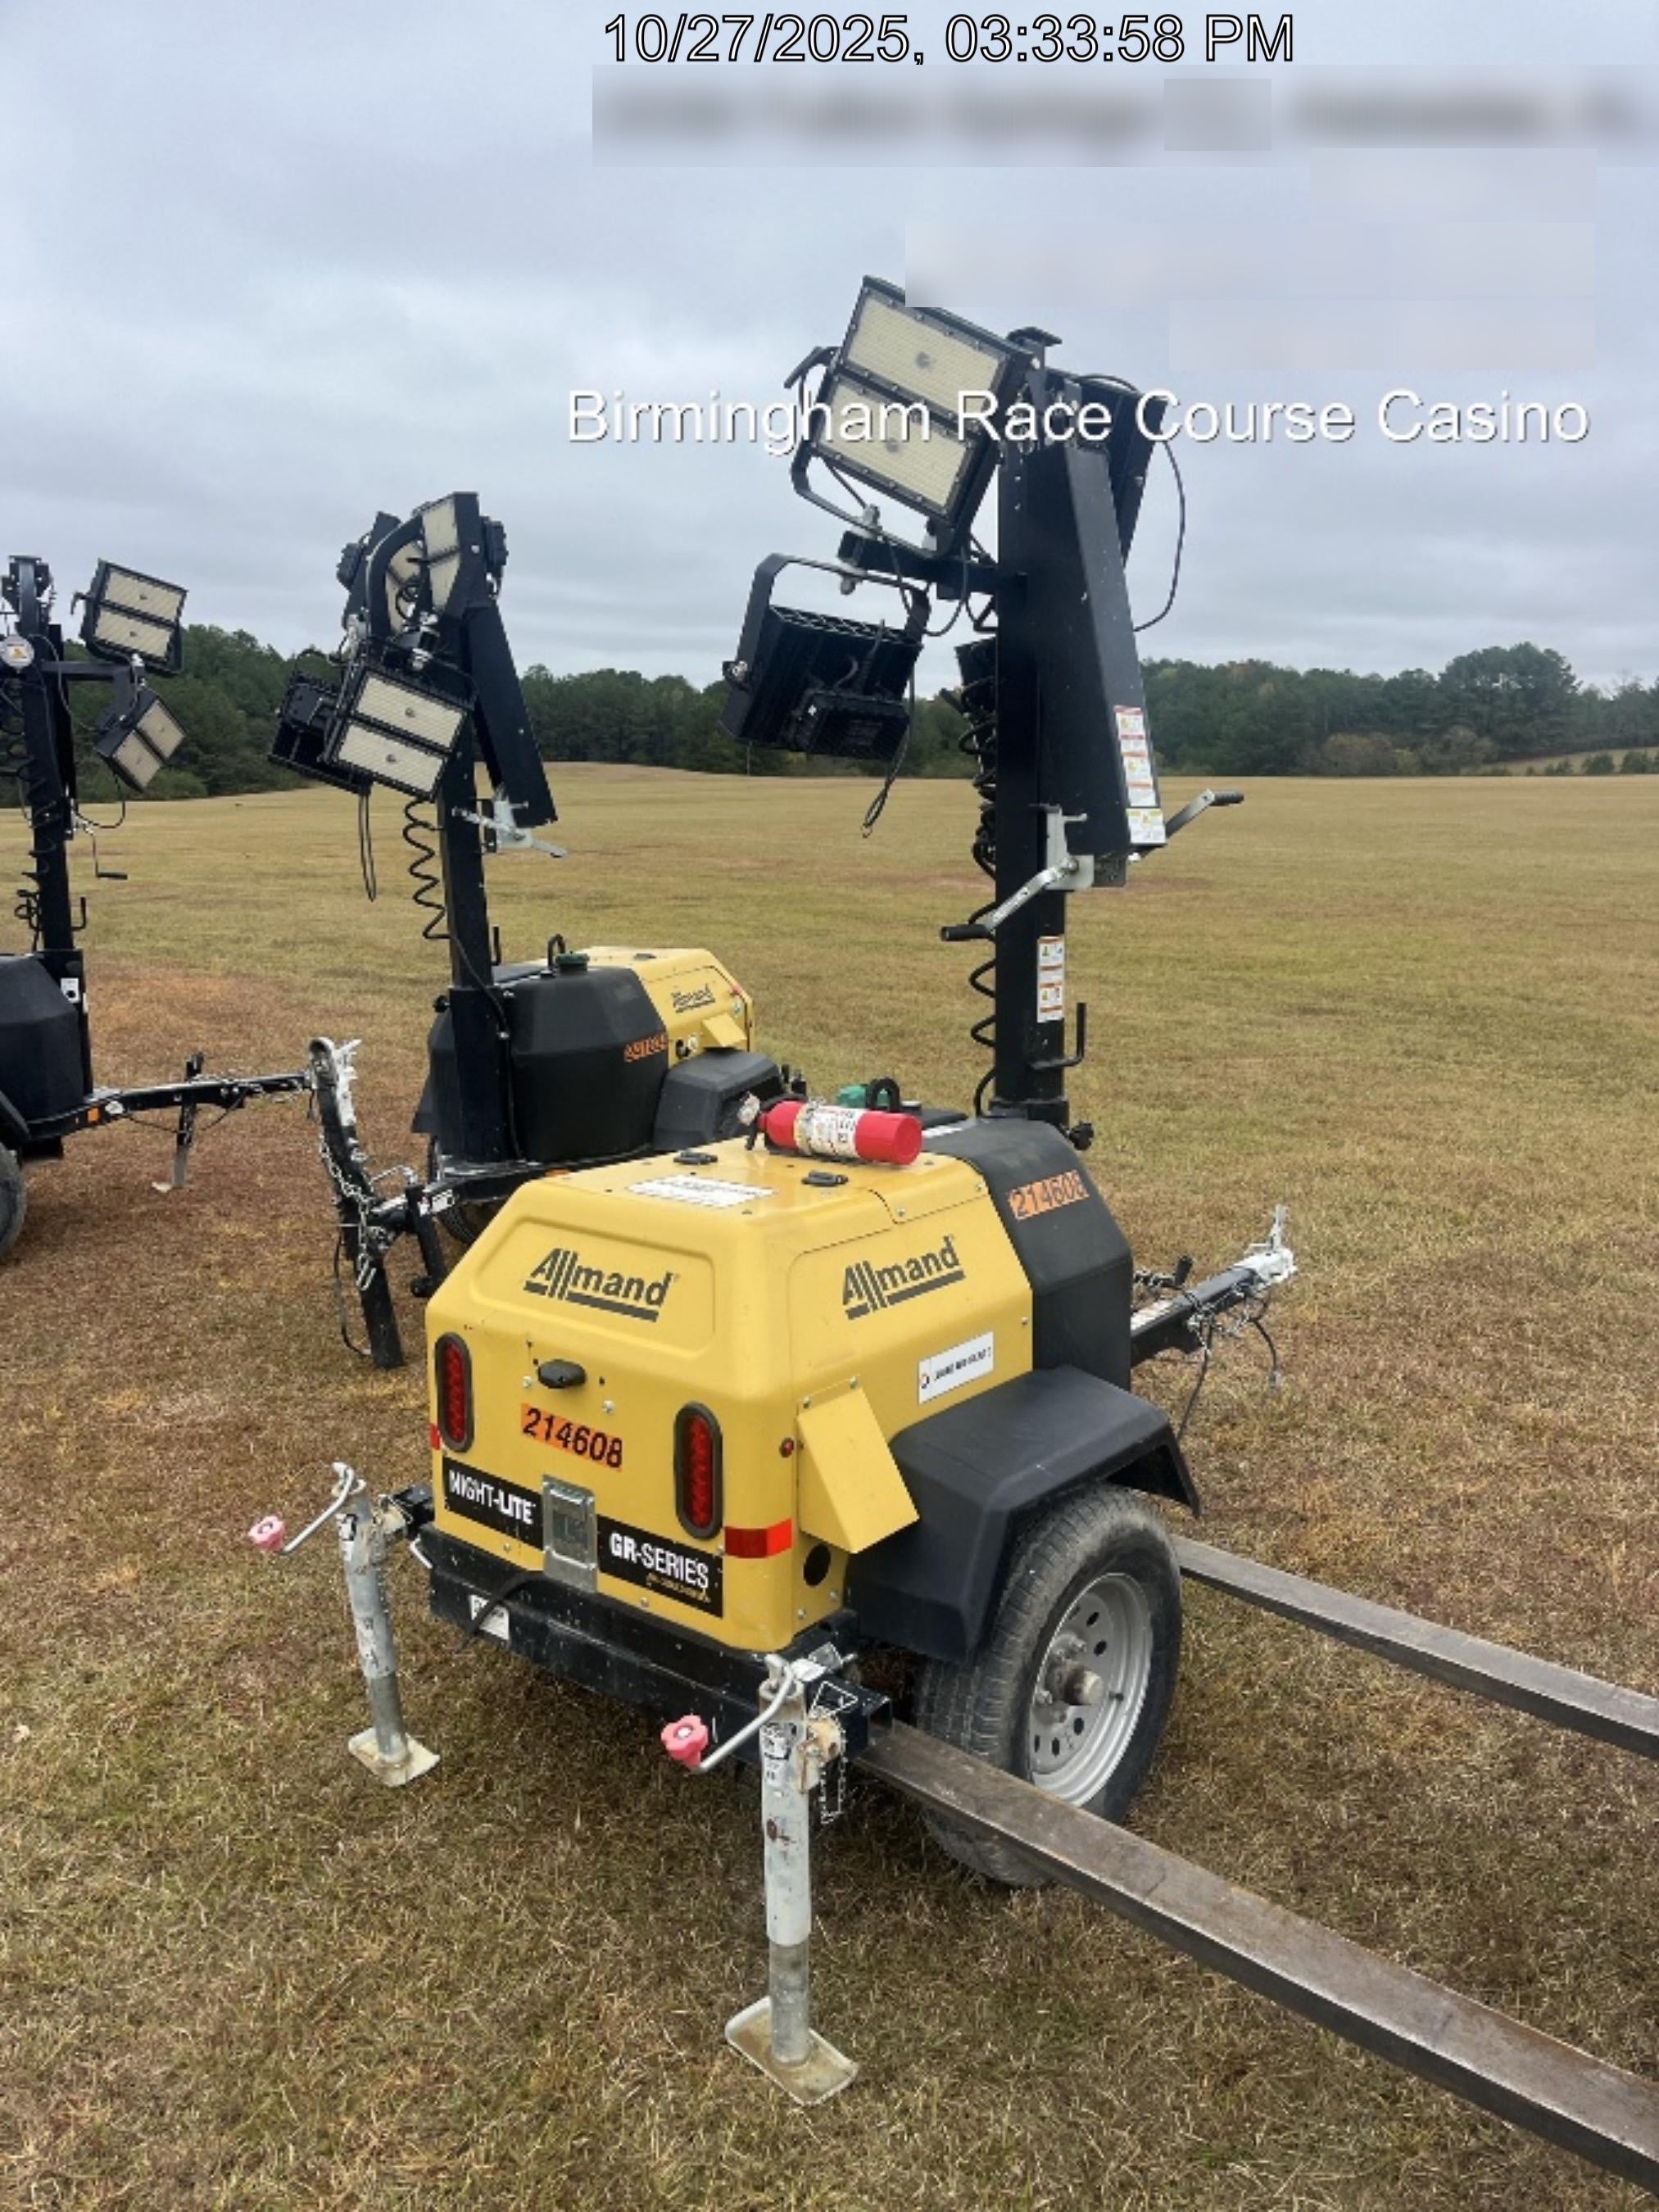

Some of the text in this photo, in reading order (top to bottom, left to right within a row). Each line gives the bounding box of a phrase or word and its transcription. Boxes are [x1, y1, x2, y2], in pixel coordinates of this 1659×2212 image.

[528, 1247, 675, 1309] Allmand
[841, 1234, 961, 1313] Allmand
[522, 1407, 623, 1469] 214608
[448, 1469, 534, 1525] NIGHT-LITE
[609, 1530, 709, 1589] GR-SERIES
